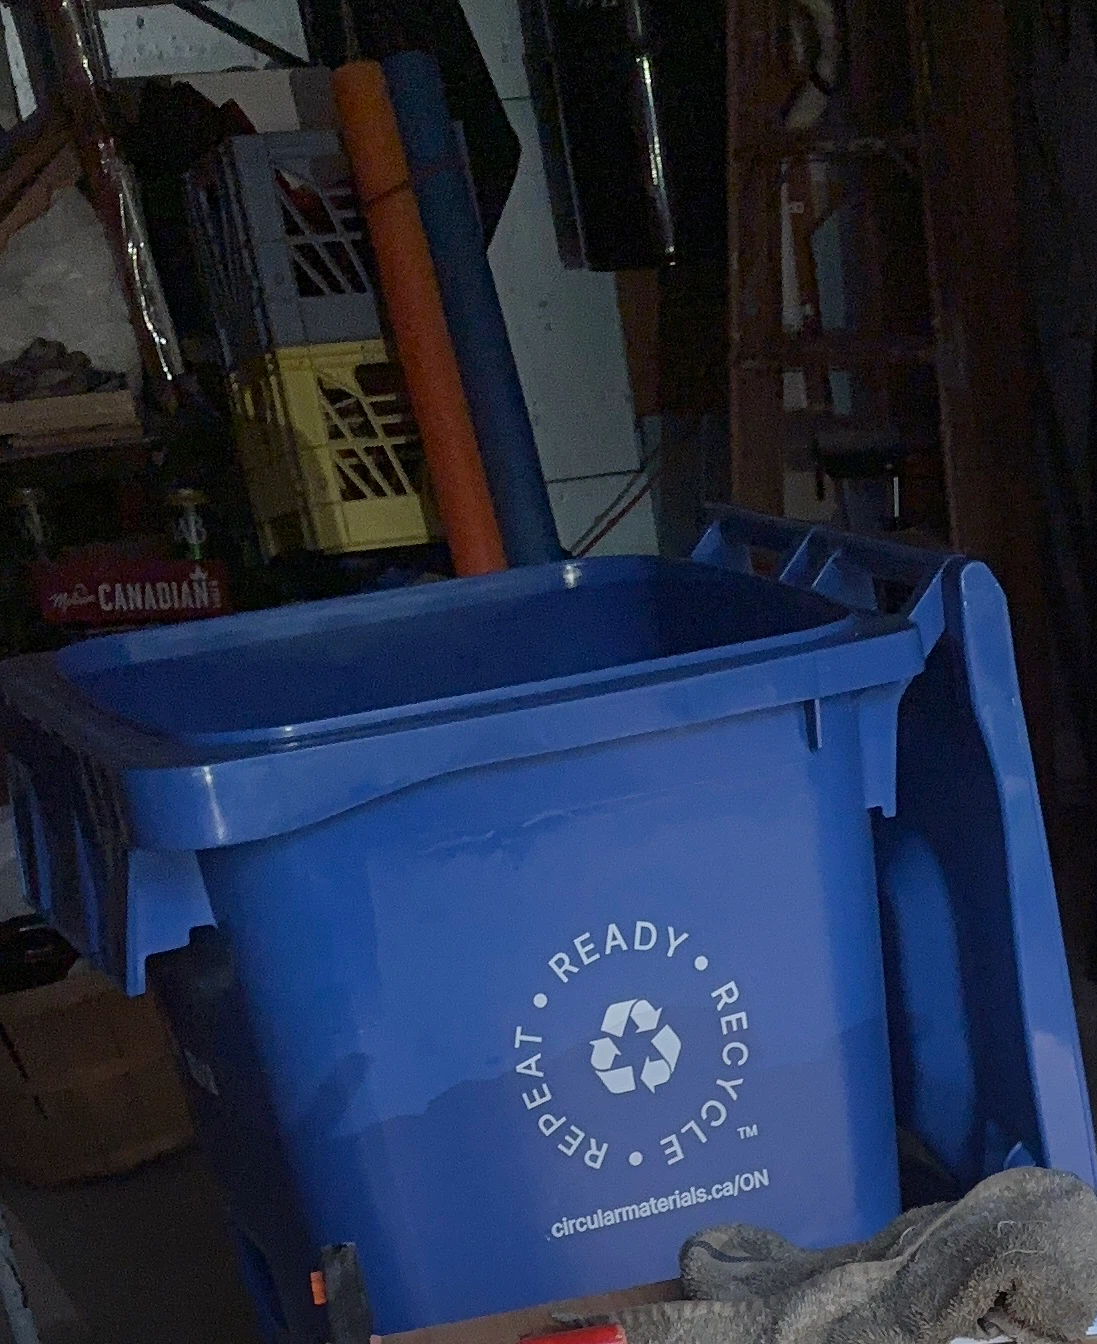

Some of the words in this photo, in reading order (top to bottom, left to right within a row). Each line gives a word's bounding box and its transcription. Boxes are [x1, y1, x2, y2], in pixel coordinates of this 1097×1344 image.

[98, 580, 209, 612] CANADIAN
[548, 920, 690, 983] READY
[514, 1026, 609, 1170] REPEAT
[660, 980, 750, 1166] RECYCLE
[551, 1168, 770, 1239] circularmaterials.ca/ON
